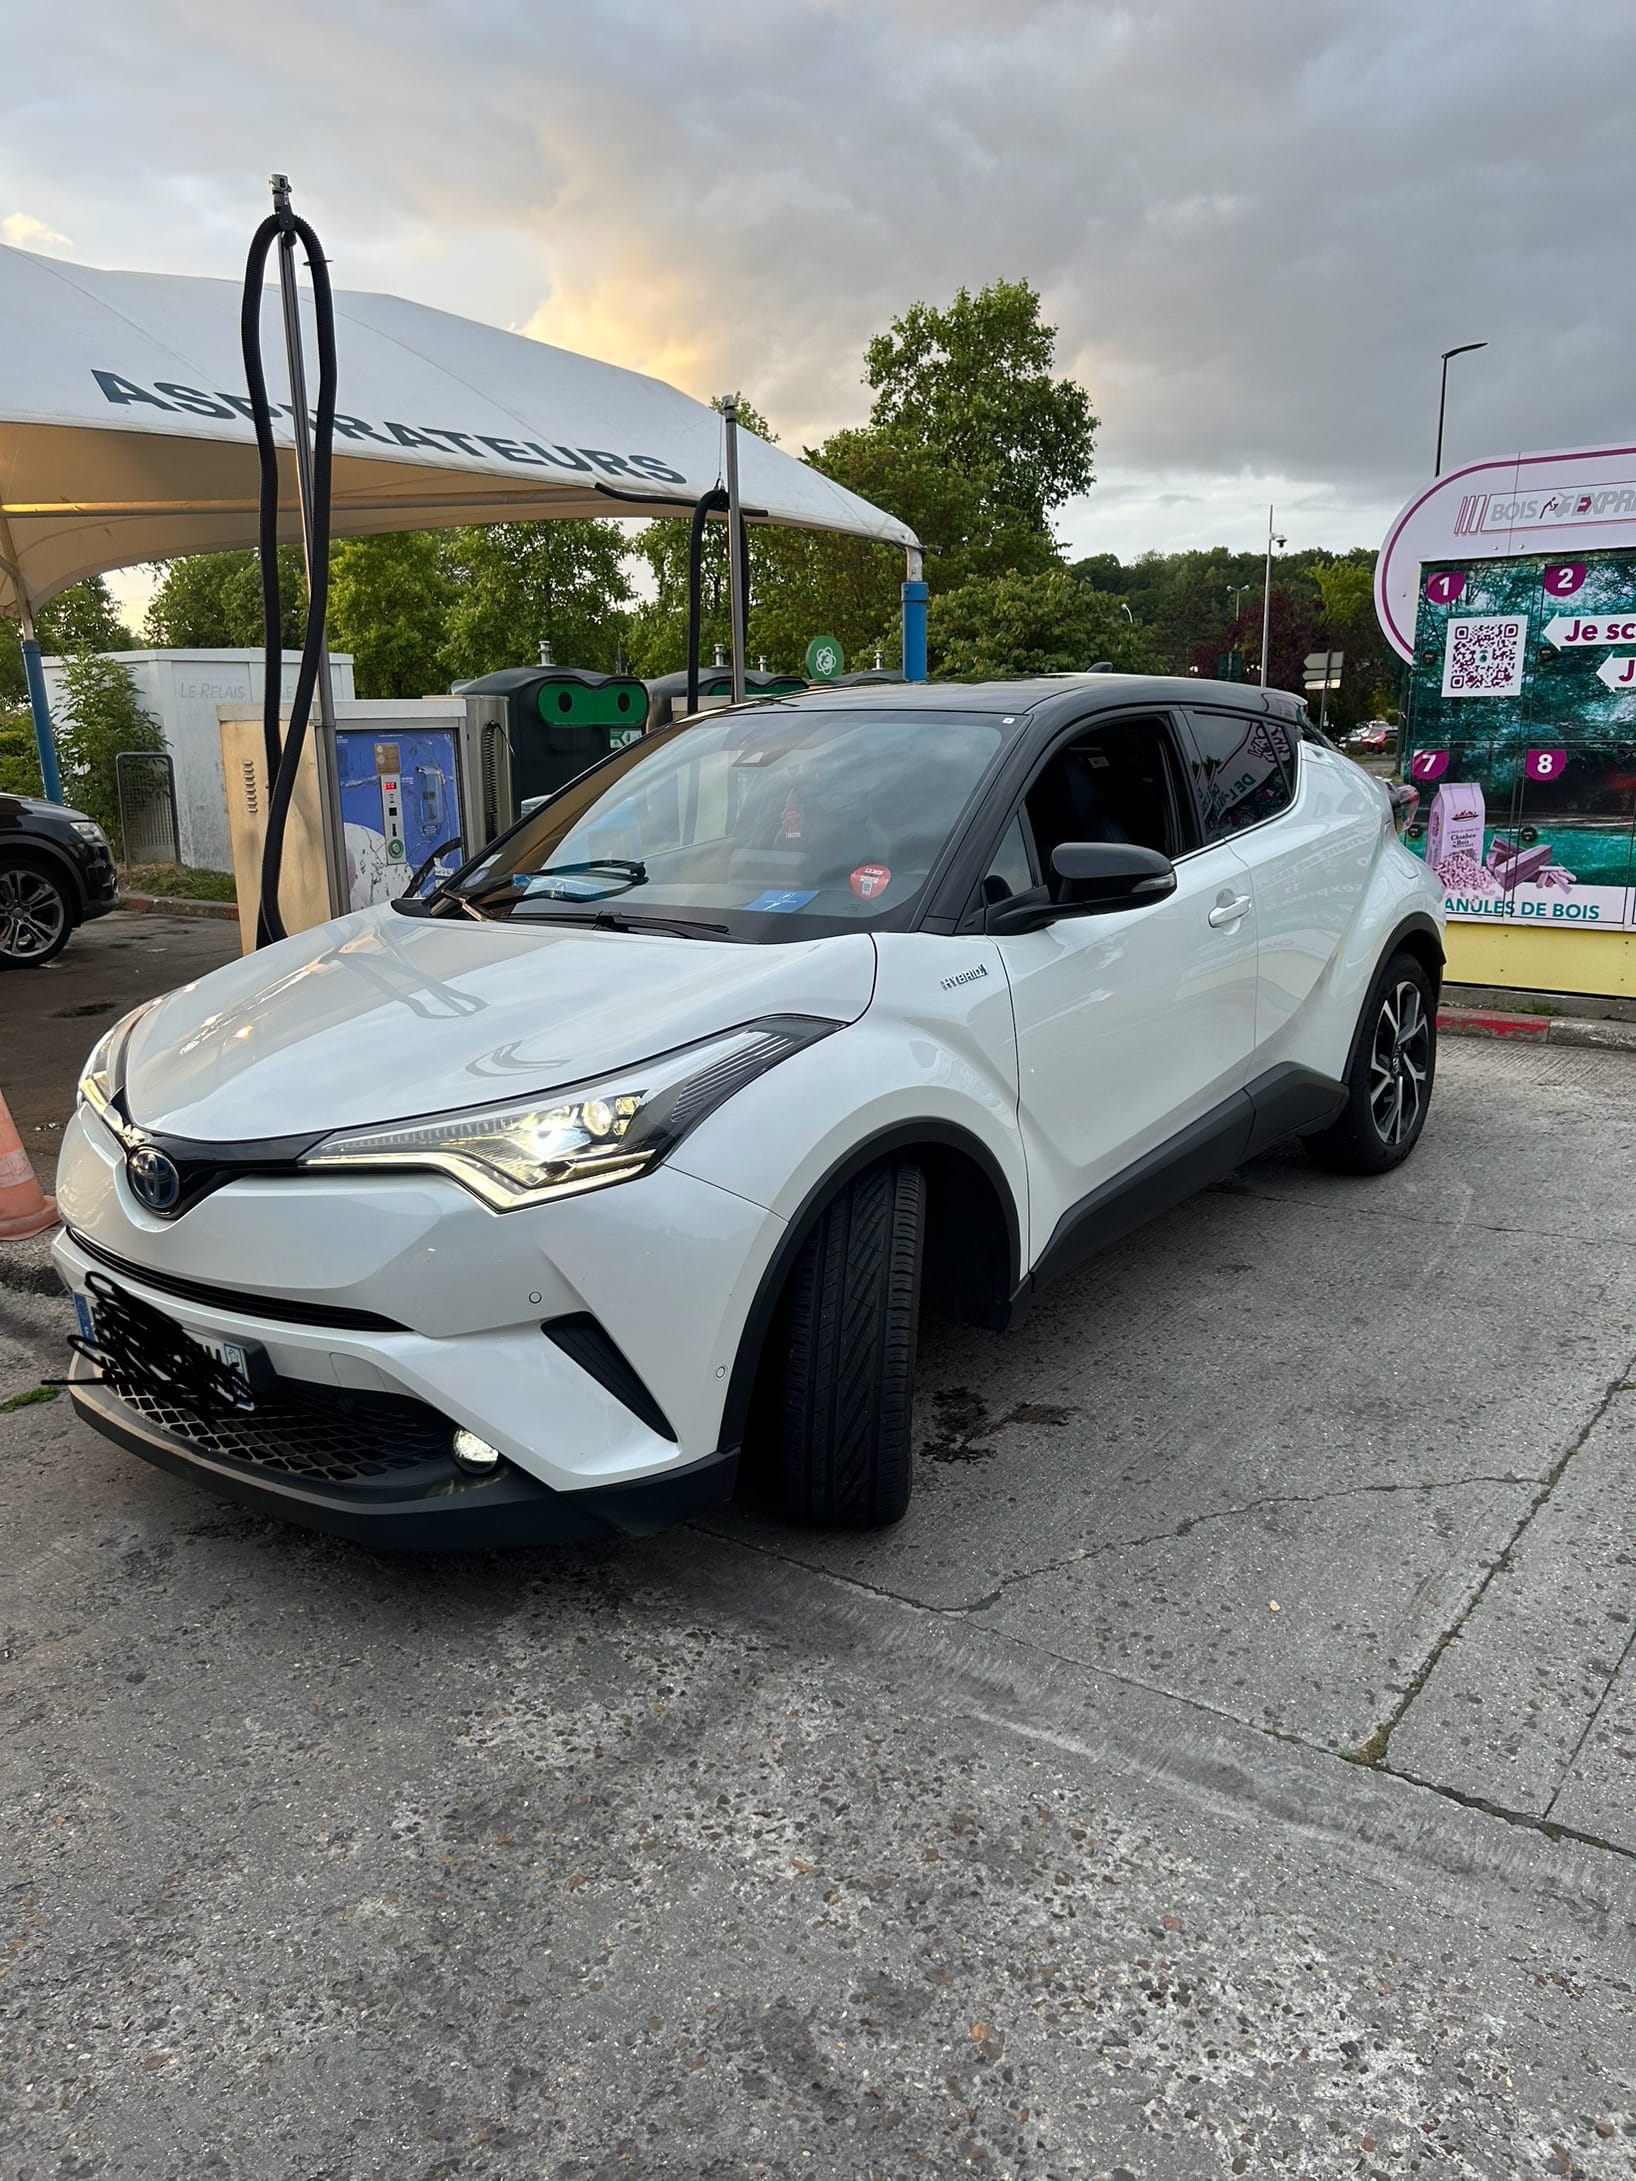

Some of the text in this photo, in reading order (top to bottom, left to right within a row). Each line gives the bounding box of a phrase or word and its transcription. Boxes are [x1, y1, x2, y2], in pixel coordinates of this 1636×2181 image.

[91, 369, 688, 485] ASPIRATEURS
[1490, 489, 1636, 522] BOIS EXPR
[1439, 576, 1450, 597] 1
[1557, 568, 1574, 589] 2
[1564, 619, 1598, 642] Je
[180, 682, 247, 699] LE RELAIS
[1422, 754, 1437, 773] 7
[1537, 753, 1553, 774] 8
[1520, 901, 1547, 917] DE
[1552, 903, 1600, 920] BOIS
